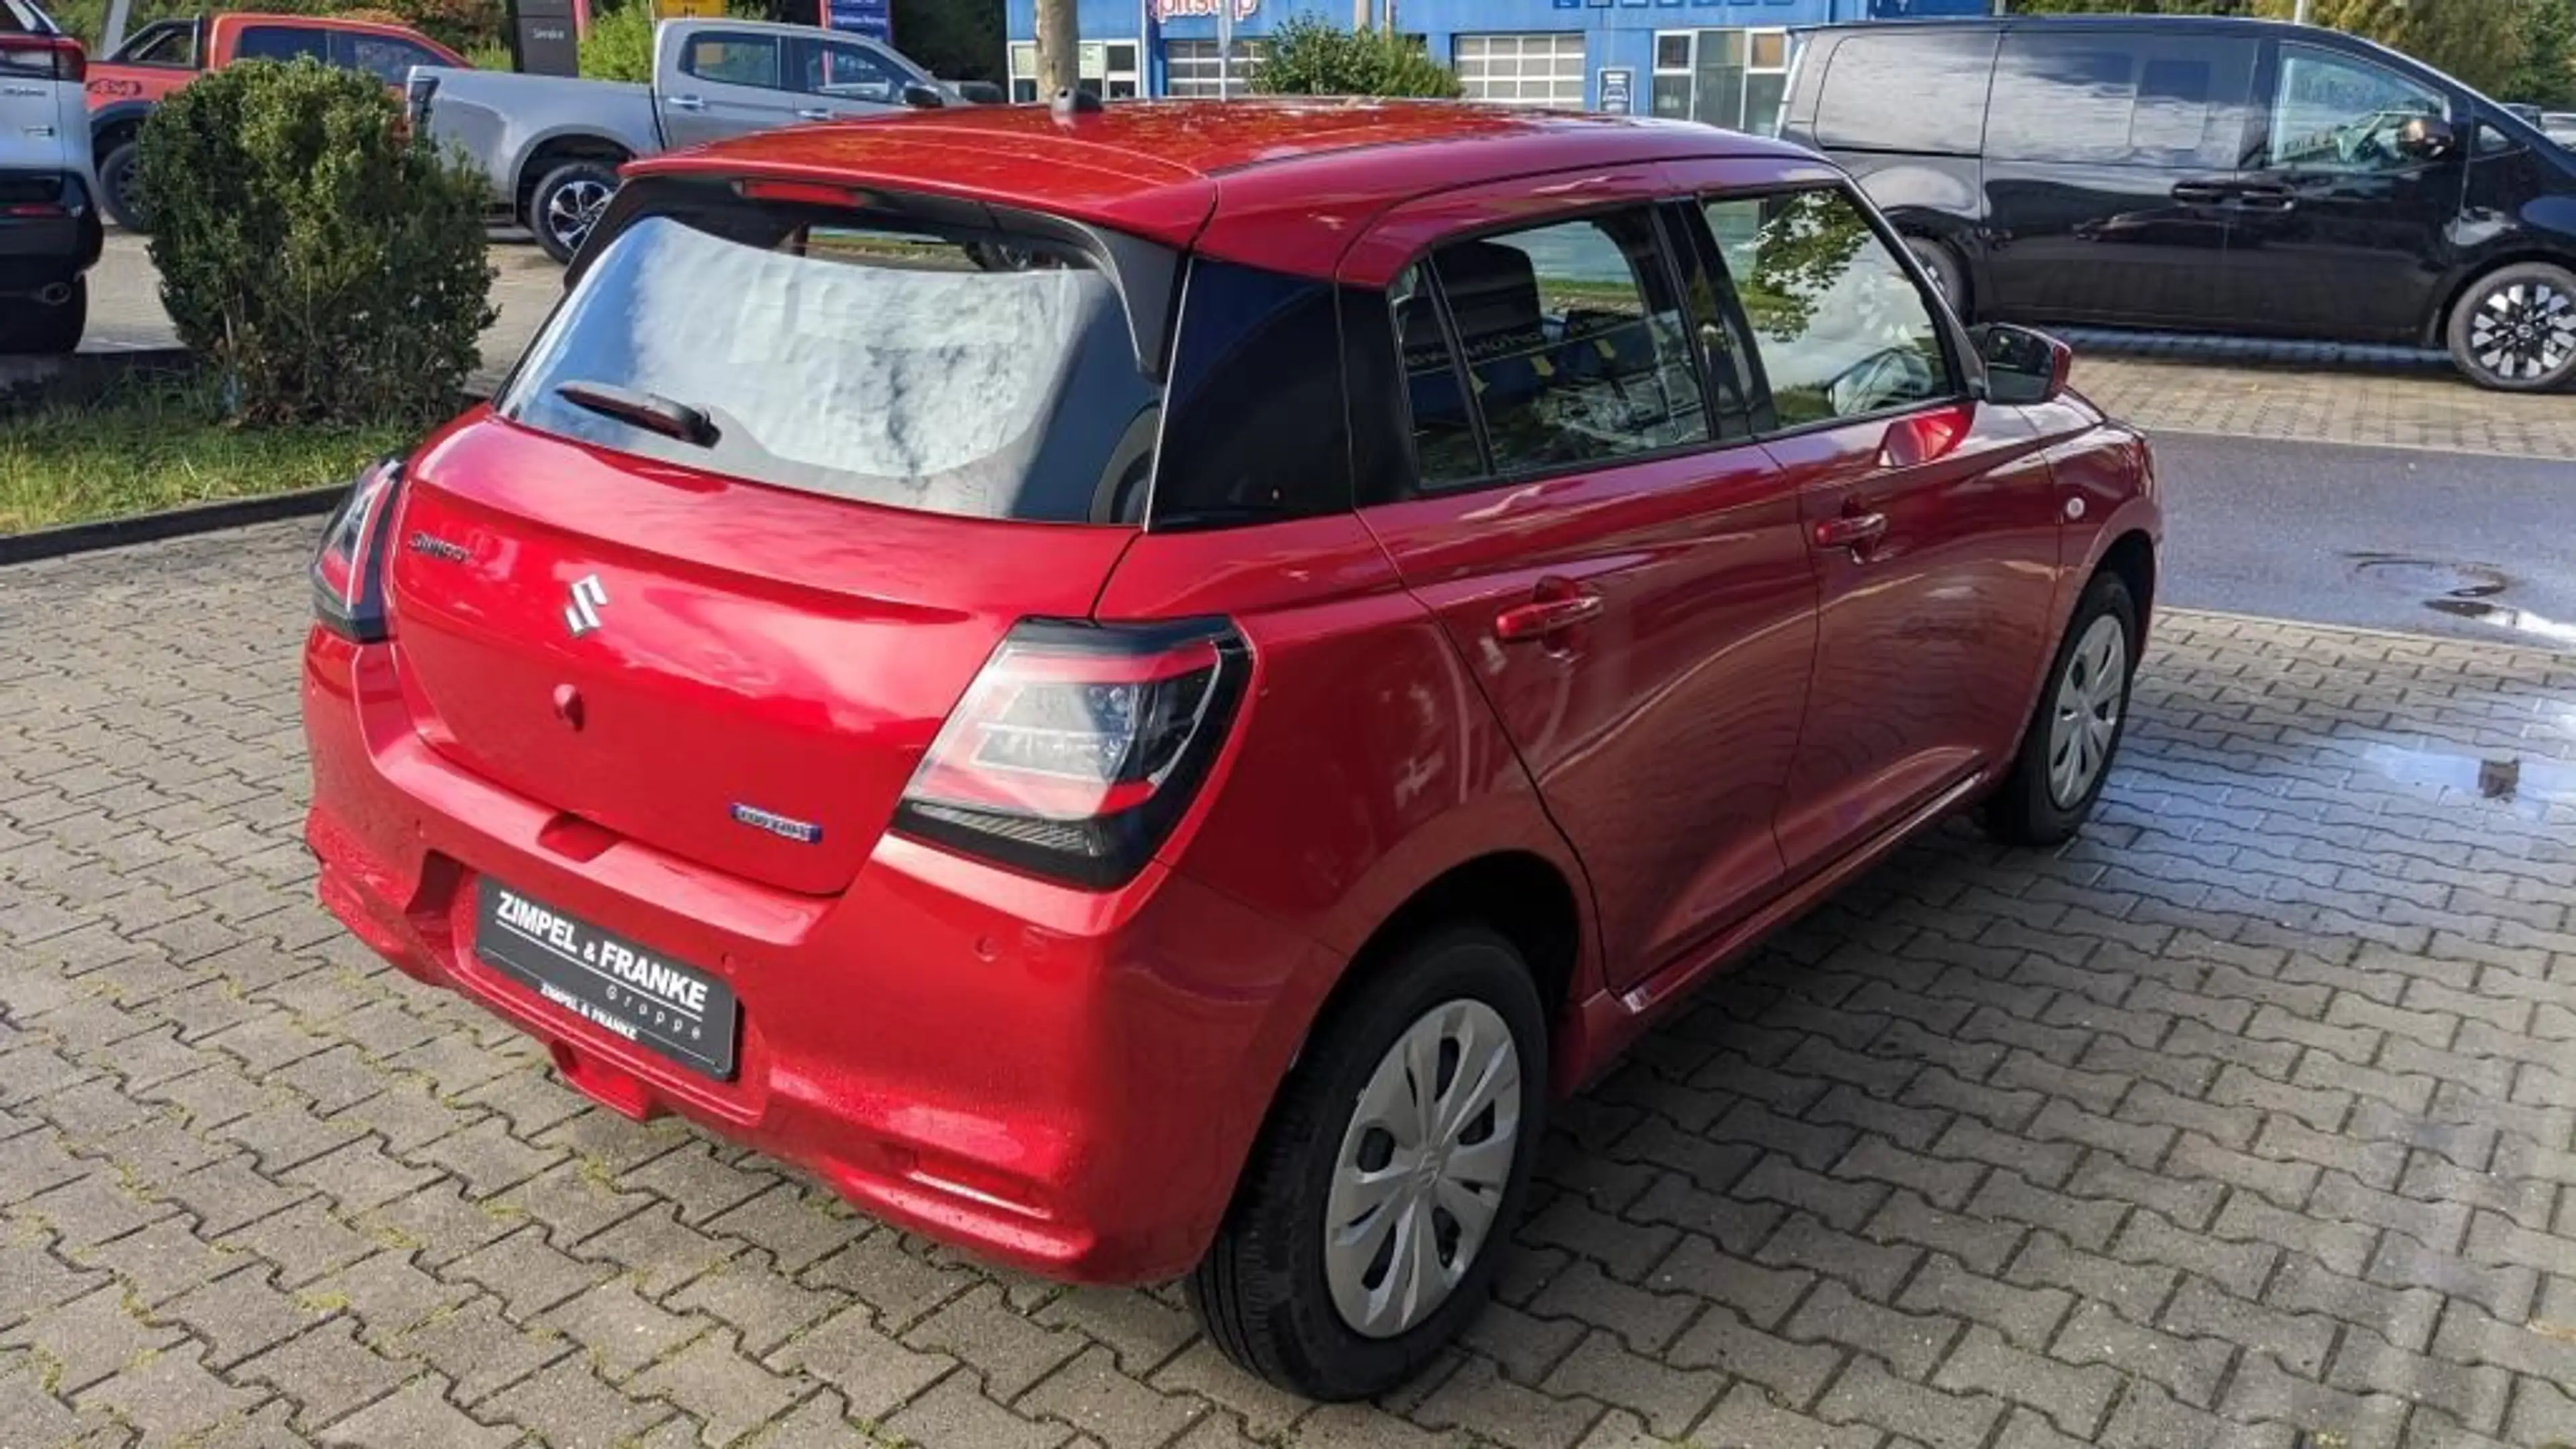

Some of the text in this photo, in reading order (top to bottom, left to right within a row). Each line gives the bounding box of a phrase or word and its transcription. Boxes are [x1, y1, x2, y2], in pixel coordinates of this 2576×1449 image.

[1157, 0, 1257, 23] pitstp
[497, 890, 708, 1012] ZIMPEL & FRANKE
[591, 1008, 637, 1040] FRANKE
